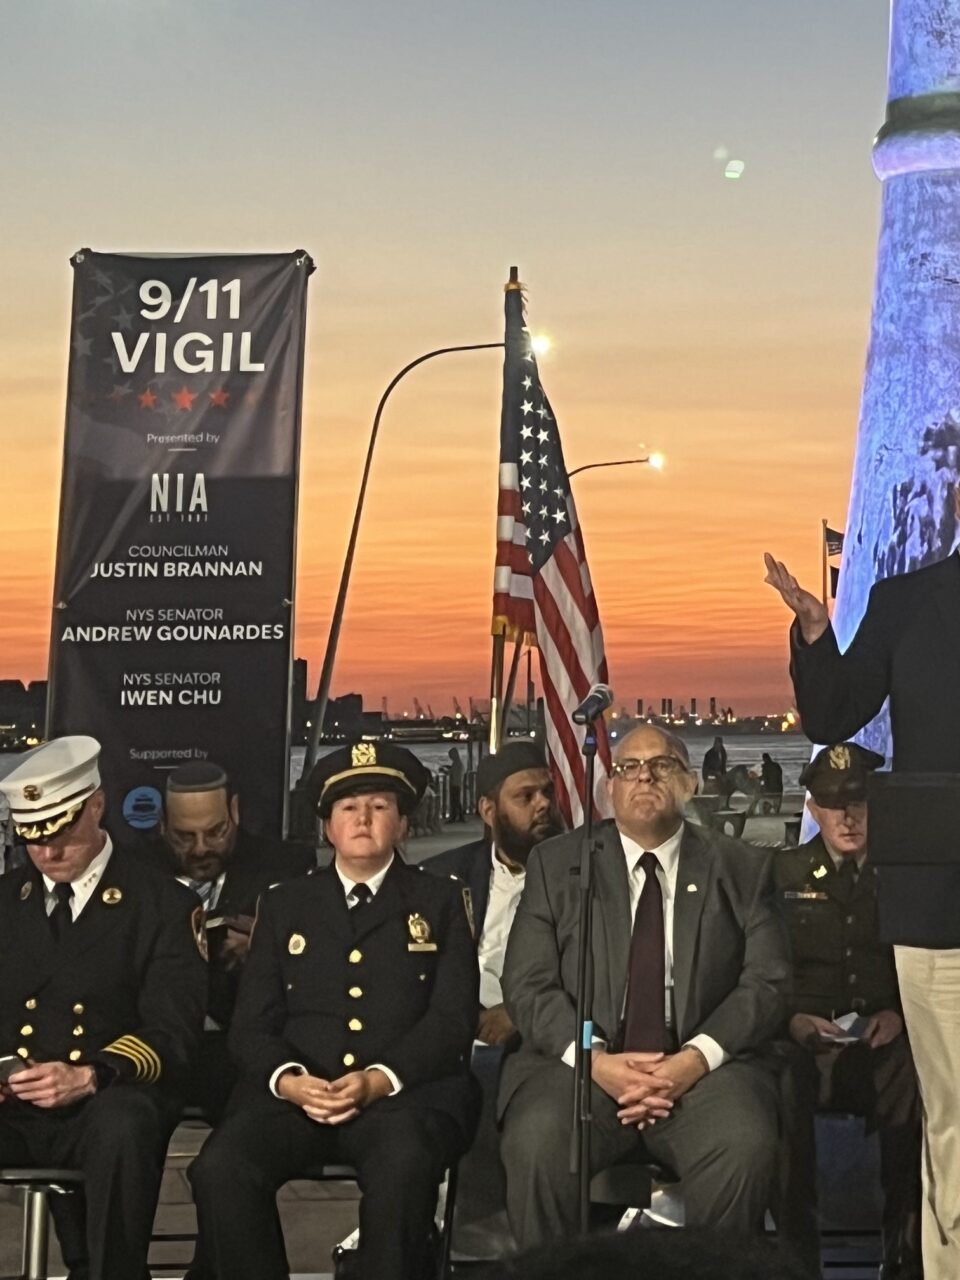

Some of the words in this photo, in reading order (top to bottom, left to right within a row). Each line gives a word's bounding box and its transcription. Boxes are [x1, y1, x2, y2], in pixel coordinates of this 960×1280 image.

[139, 278, 241, 324] 9/11
[111, 332, 265, 374] VIGIL
[146, 432, 204, 444] Presented
[205, 431, 221, 444] by
[150, 472, 208, 512] NIA
[128, 544, 229, 558] COUNCILMAN
[89, 562, 158, 578] JUSTIN
[163, 560, 263, 577] BRANNAN
[126, 608, 155, 622] NYS
[158, 608, 224, 621] SENATOR
[61, 625, 153, 642] ANDREW
[156, 624, 284, 642] GOUNARDES
[123, 673, 152, 686] NYS
[154, 672, 221, 686] SENATOR
[120, 690, 173, 706] IWEN
[178, 689, 222, 705] CHU
[129, 747, 192, 760] Supported
[194, 747, 209, 760] by
